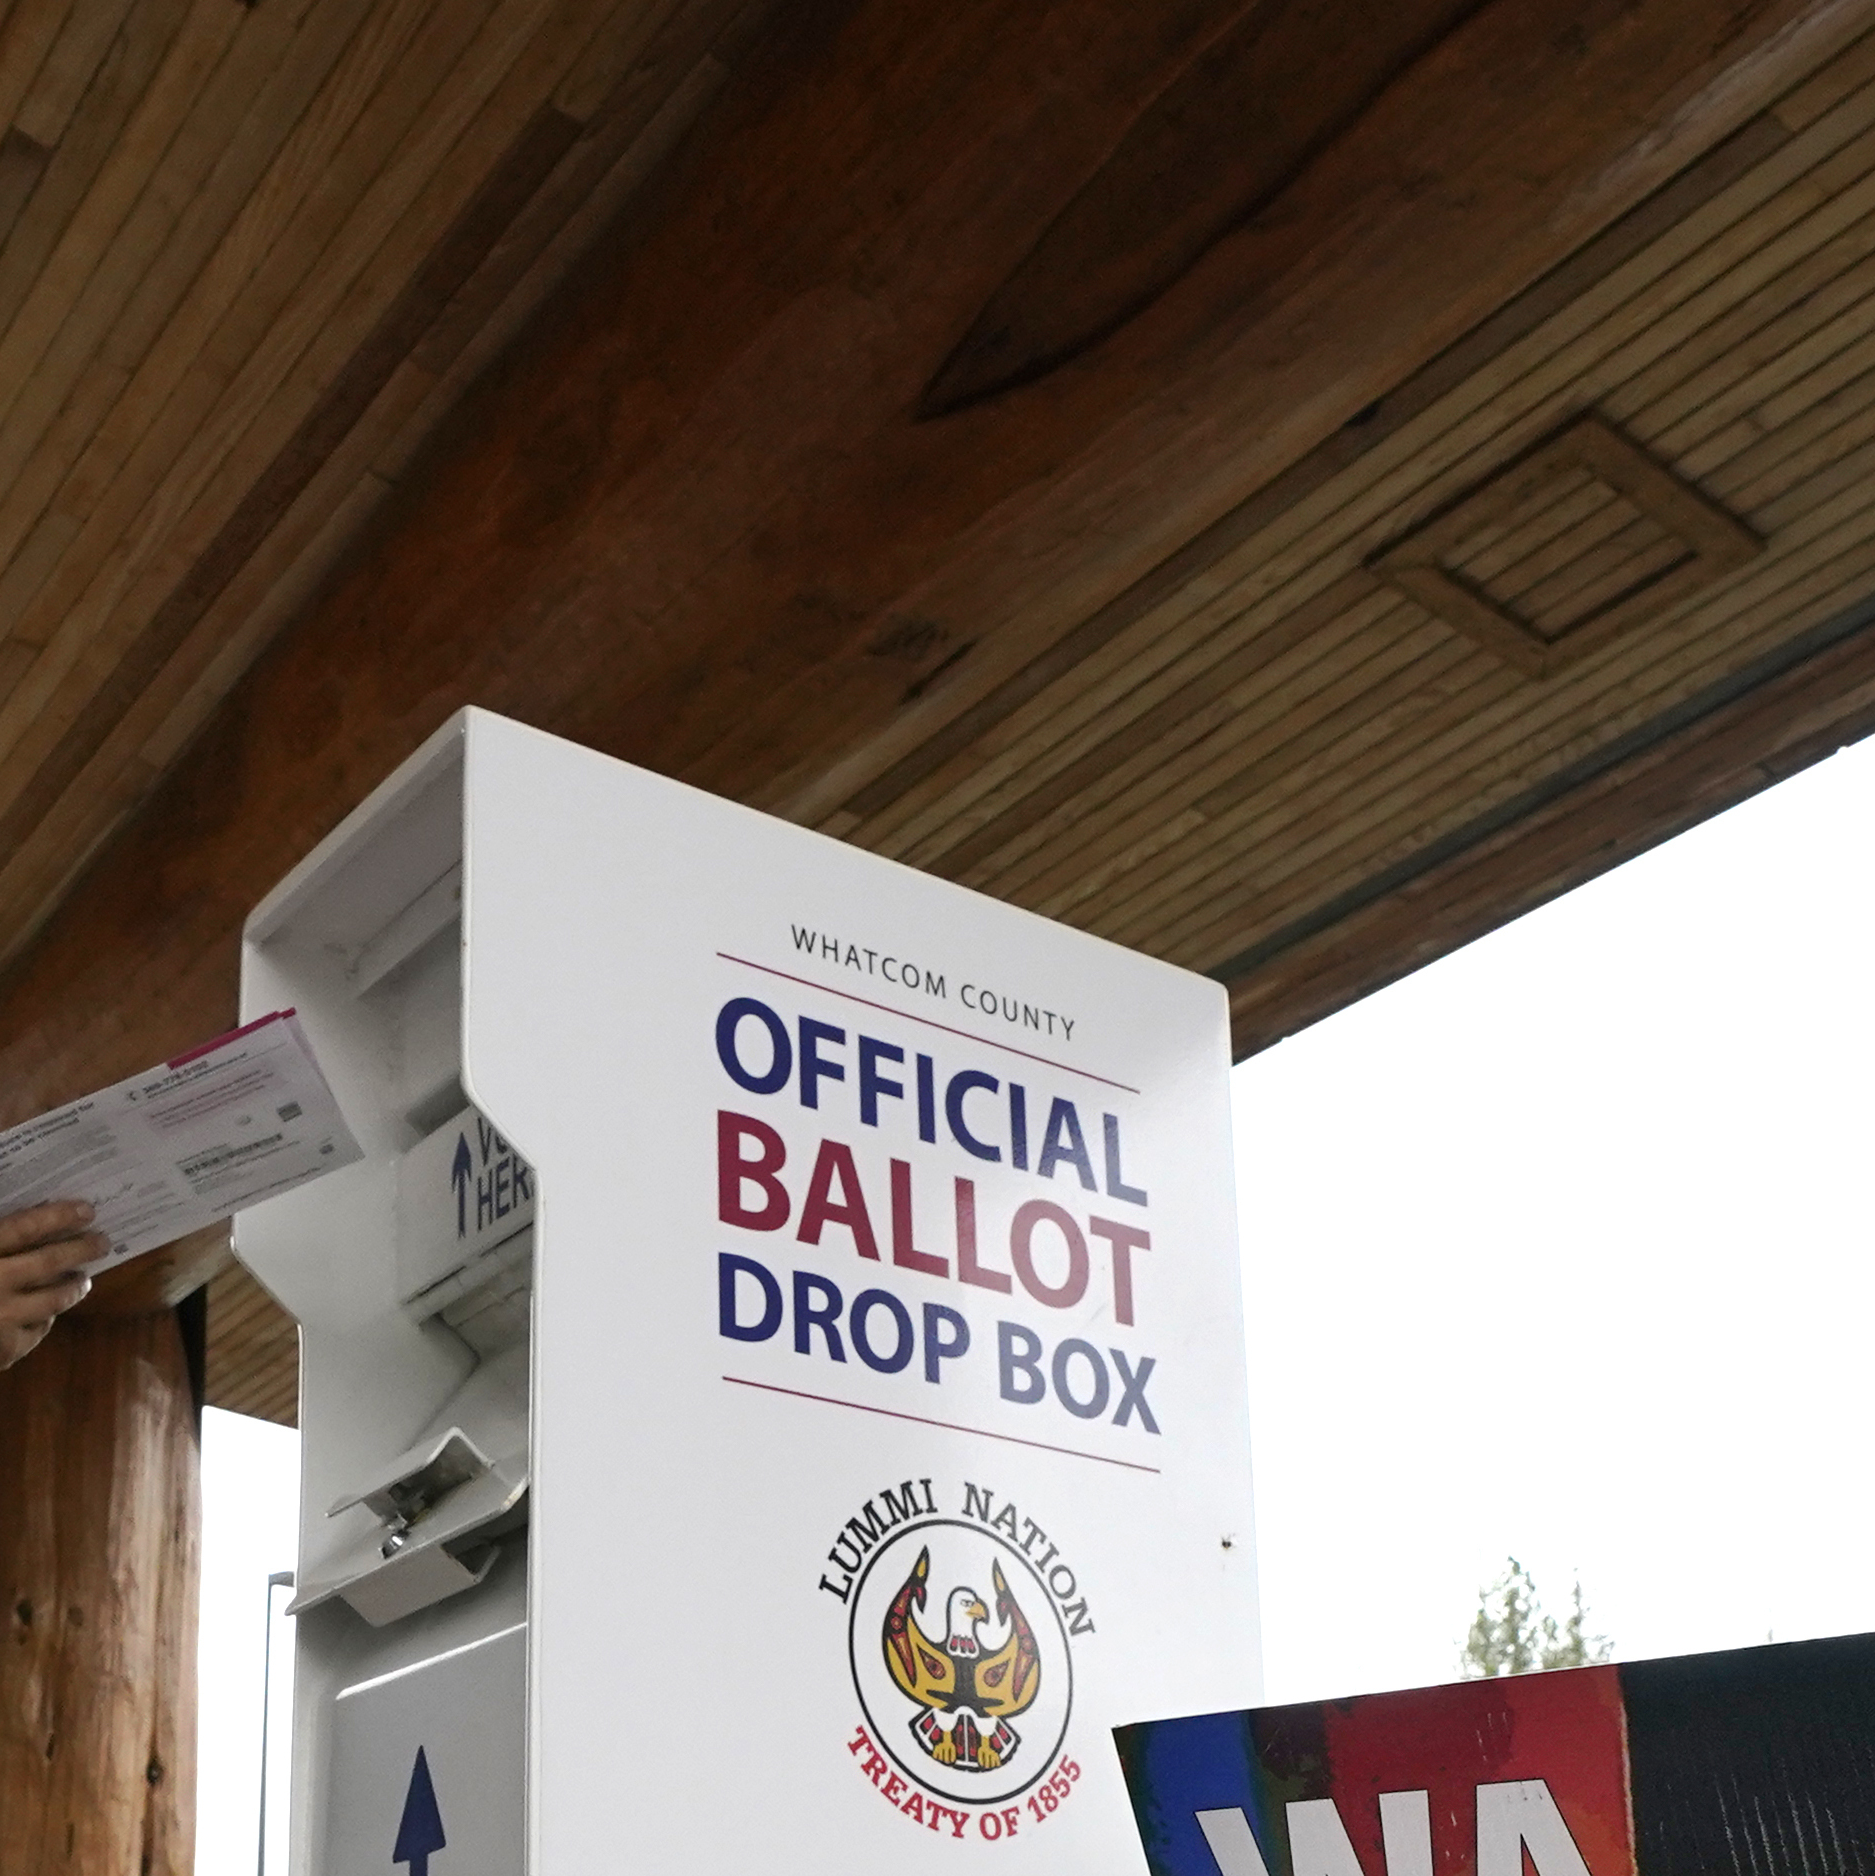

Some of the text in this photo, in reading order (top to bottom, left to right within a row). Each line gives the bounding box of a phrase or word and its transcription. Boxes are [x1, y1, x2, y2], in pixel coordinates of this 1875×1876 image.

[791, 924, 1075, 1042] WHATCOM COUNTY
[715, 996, 1149, 1208] OFFICIAL
[477, 1154, 535, 1233] HER
[717, 1109, 1152, 1328] BALLOT
[718, 1252, 1162, 1437] DROP BOX
[819, 1478, 1096, 1639] LUMMI NATION
[847, 1725, 1083, 1842] TREATY OF 1855
